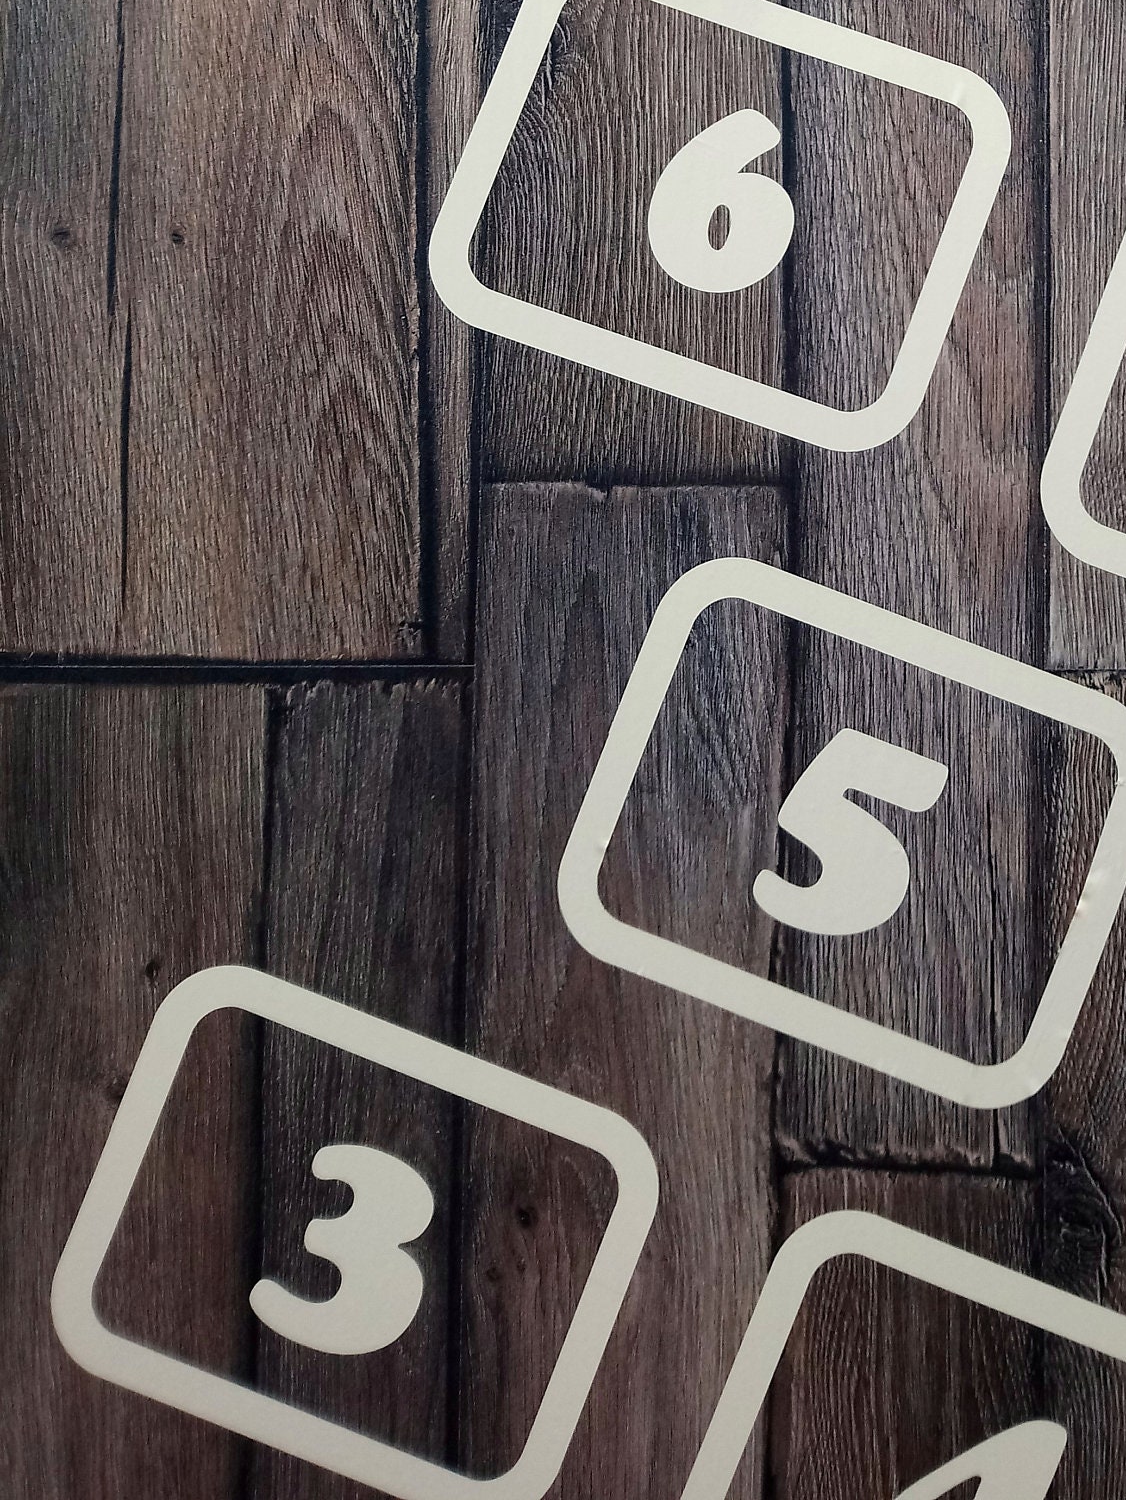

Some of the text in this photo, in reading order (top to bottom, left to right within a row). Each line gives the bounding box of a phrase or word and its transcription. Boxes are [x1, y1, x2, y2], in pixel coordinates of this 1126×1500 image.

[648, 107, 795, 294] 6
[753, 728, 949, 936] 5
[250, 1145, 434, 1355] 3
